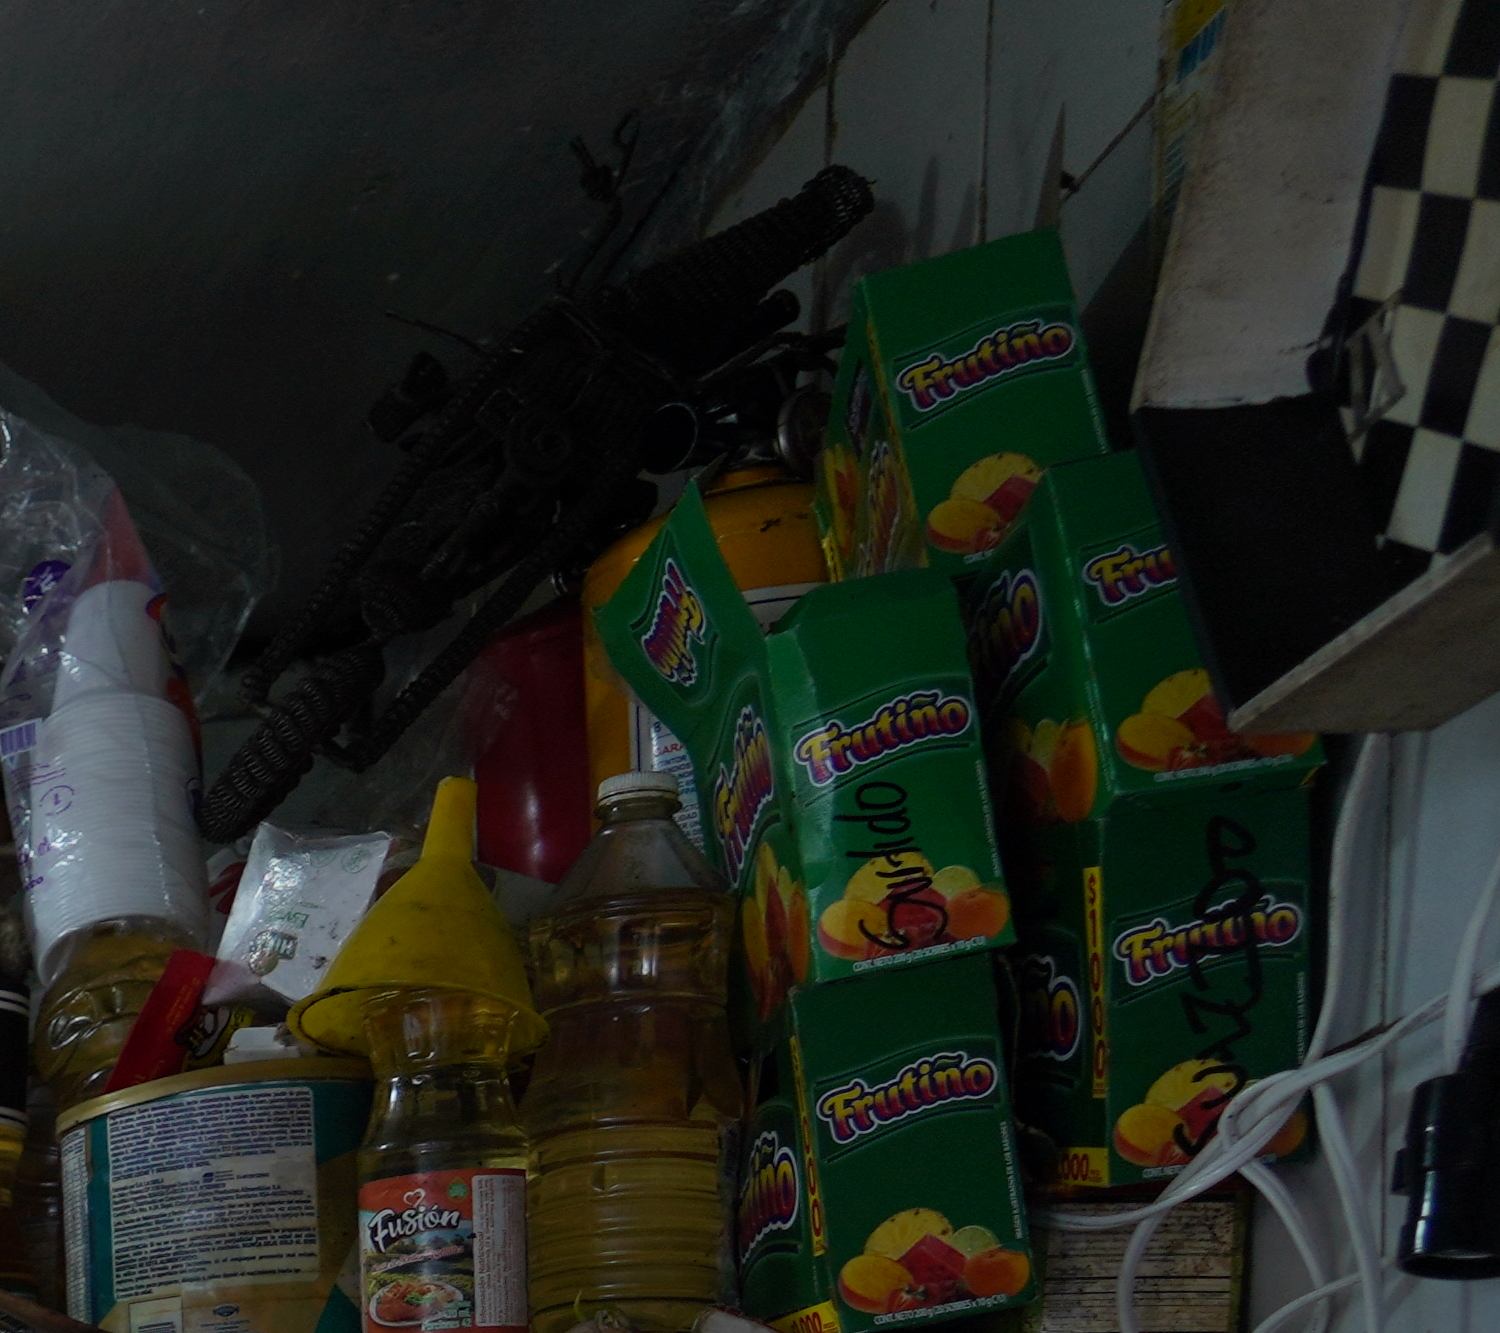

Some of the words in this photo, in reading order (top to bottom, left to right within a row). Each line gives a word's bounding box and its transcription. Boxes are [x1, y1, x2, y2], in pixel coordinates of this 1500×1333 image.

[898, 319, 1076, 412] Frutiño
[794, 689, 972, 789] Frutiño
[834, 781, 950, 950] Surtido
[815, 1050, 998, 1145] Frutiño
[368, 1203, 461, 1253] Fusión
